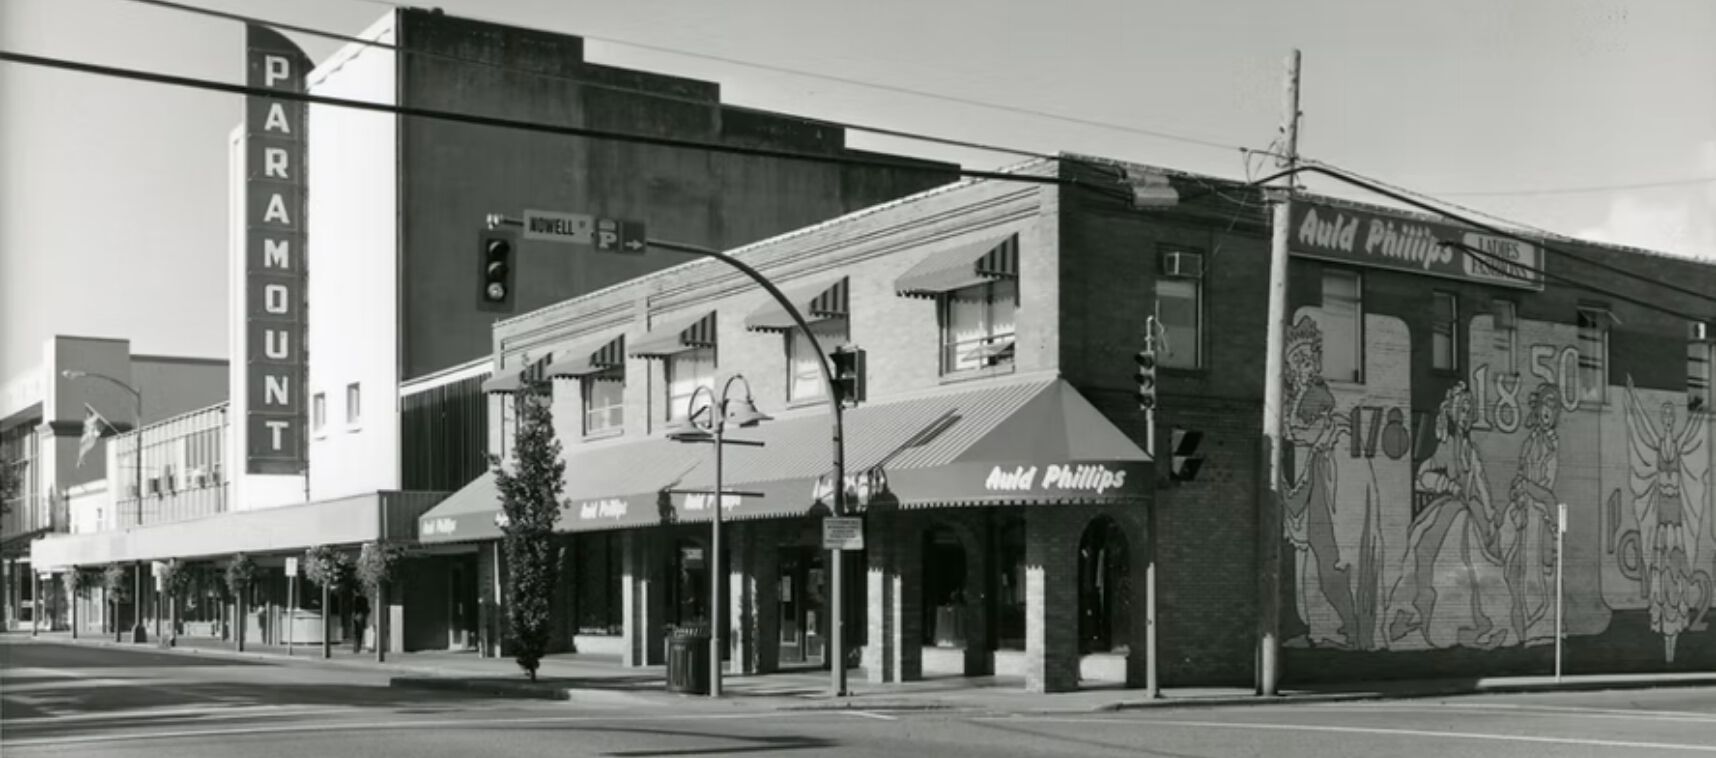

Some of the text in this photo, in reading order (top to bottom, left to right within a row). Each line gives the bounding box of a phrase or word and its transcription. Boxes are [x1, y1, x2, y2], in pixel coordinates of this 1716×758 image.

[529, 216, 575, 236] NOWELL
[1298, 207, 1454, 270] Auld Phillips
[264, 55, 290, 450] PARAMOUNT
[985, 464, 1126, 494] Auld Phillips
